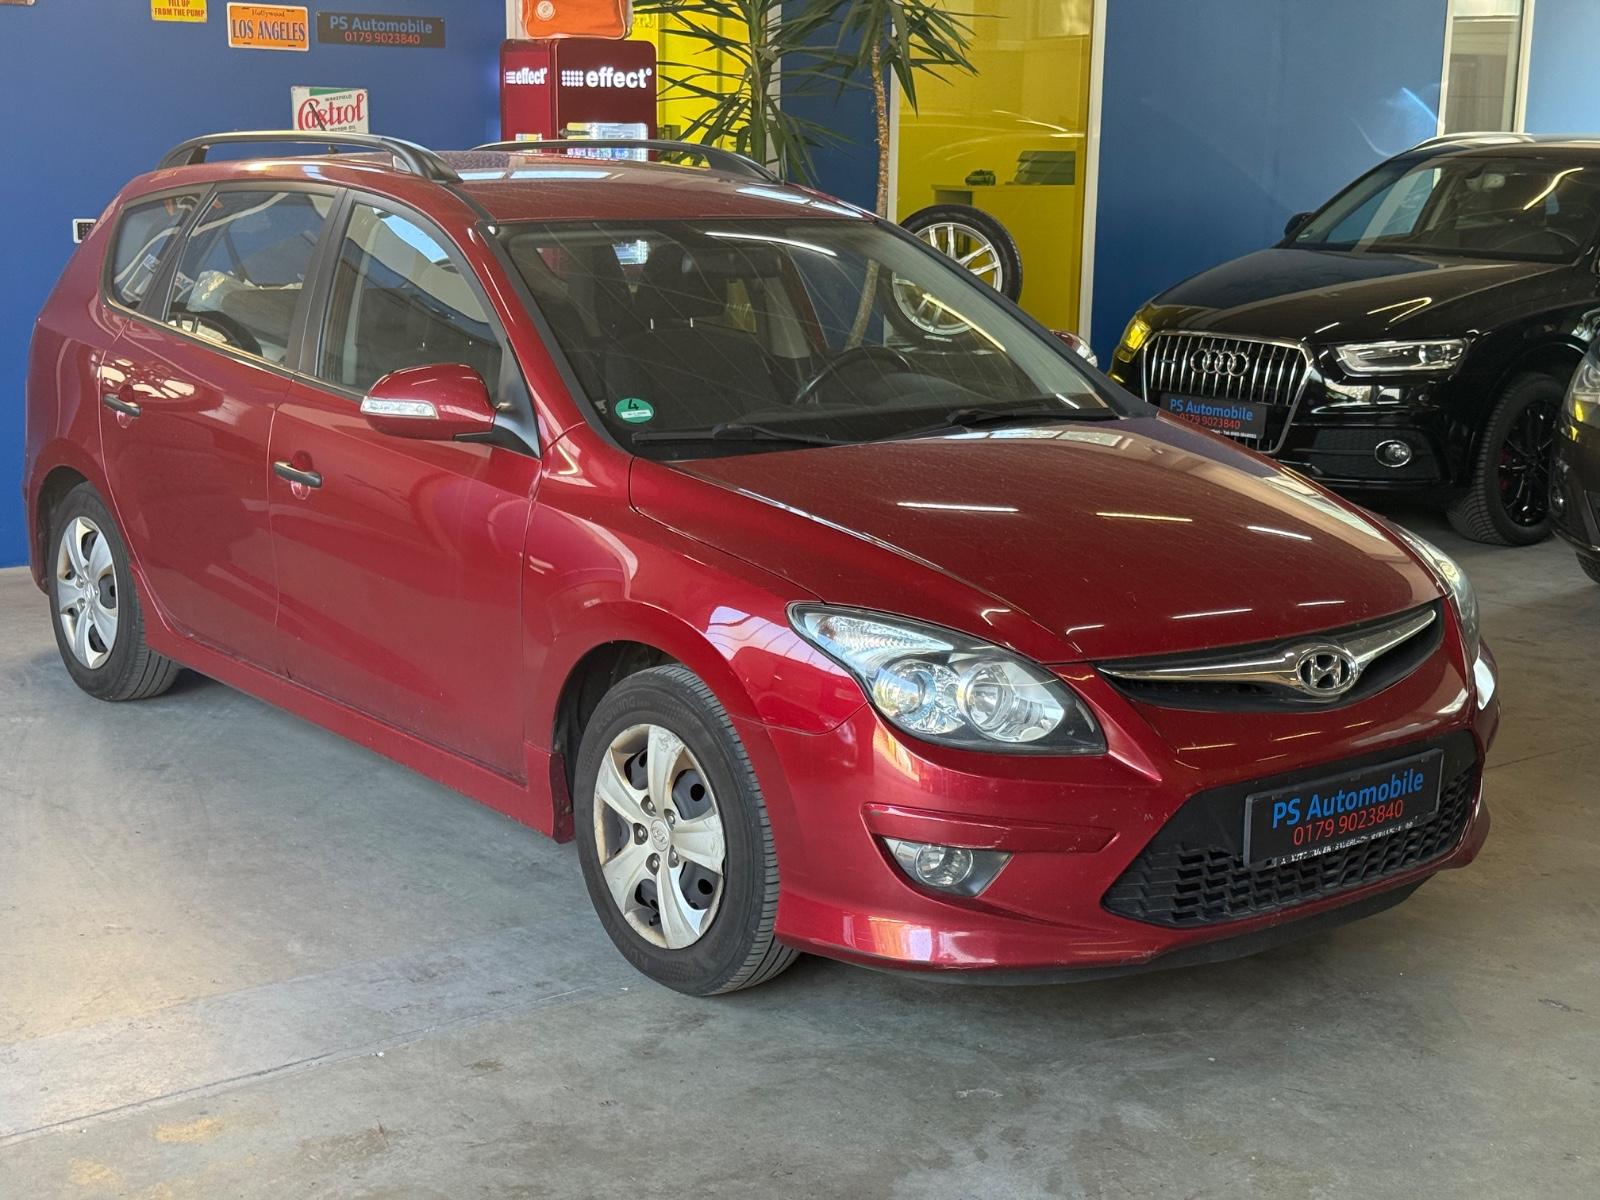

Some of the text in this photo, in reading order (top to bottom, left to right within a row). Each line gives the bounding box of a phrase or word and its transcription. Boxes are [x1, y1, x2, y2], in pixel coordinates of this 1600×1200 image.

[154, 7, 205, 17] FROM THE PUMP
[232, 19, 306, 42] LOS ANGELES
[330, 15, 433, 33] PS Automobile
[344, 31, 421, 44] 0179 9023840
[298, 93, 365, 131] Castrol
[628, 399, 639, 410] 4
[1170, 399, 1254, 421] PS Automobile
[1201, 415, 1241, 430] 9023840
[1272, 768, 1424, 830] PS Automobile
[1293, 817, 1335, 846] 0179
[1339, 799, 1403, 835] 9023840
